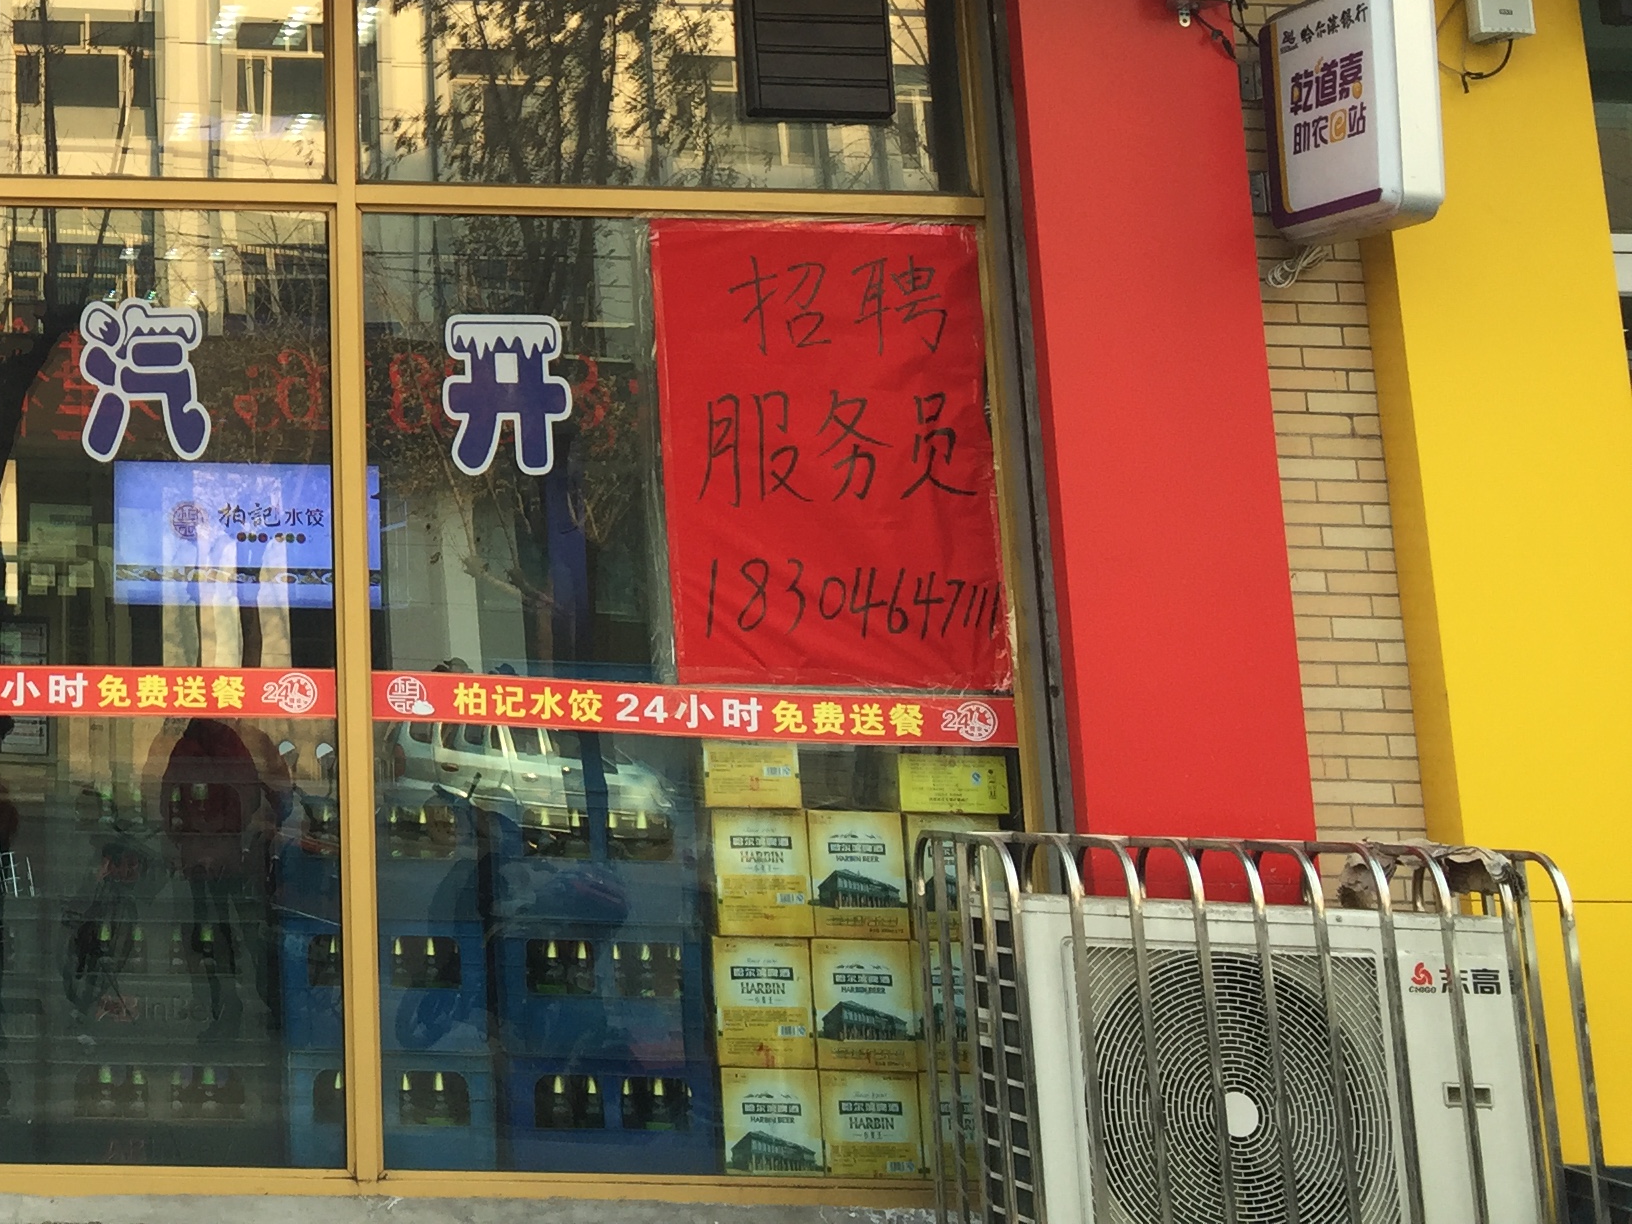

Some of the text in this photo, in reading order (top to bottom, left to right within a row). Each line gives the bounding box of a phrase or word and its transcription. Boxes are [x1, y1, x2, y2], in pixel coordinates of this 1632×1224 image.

[728, 255, 949, 356] 招聘
[696, 389, 978, 508] 服务员
[740, 982, 786, 995] HARBIN
[849, 1117, 895, 1129] HARBIN
